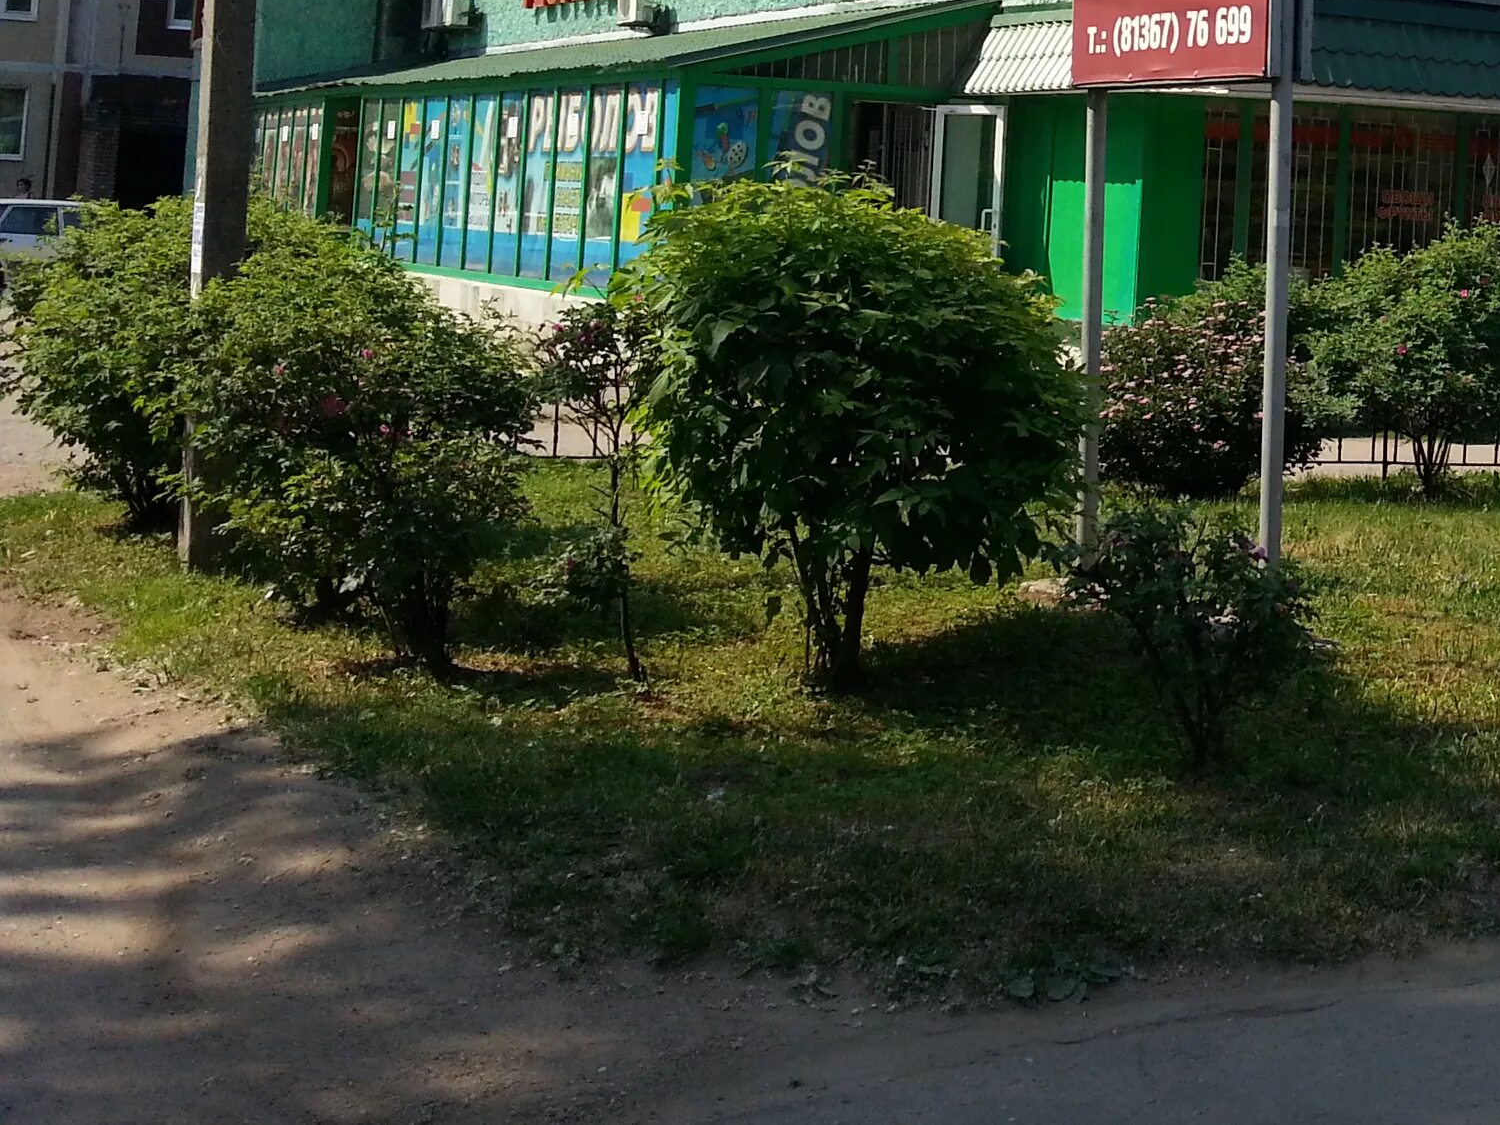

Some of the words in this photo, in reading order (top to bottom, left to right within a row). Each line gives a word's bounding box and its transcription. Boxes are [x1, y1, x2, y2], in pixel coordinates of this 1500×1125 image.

[1113, 11, 1180, 58] (81367)
[1186, 9, 1209, 48] 76
[1215, 4, 1252, 45] 699
[528, 89, 660, 153] РЫБОЛОВ
